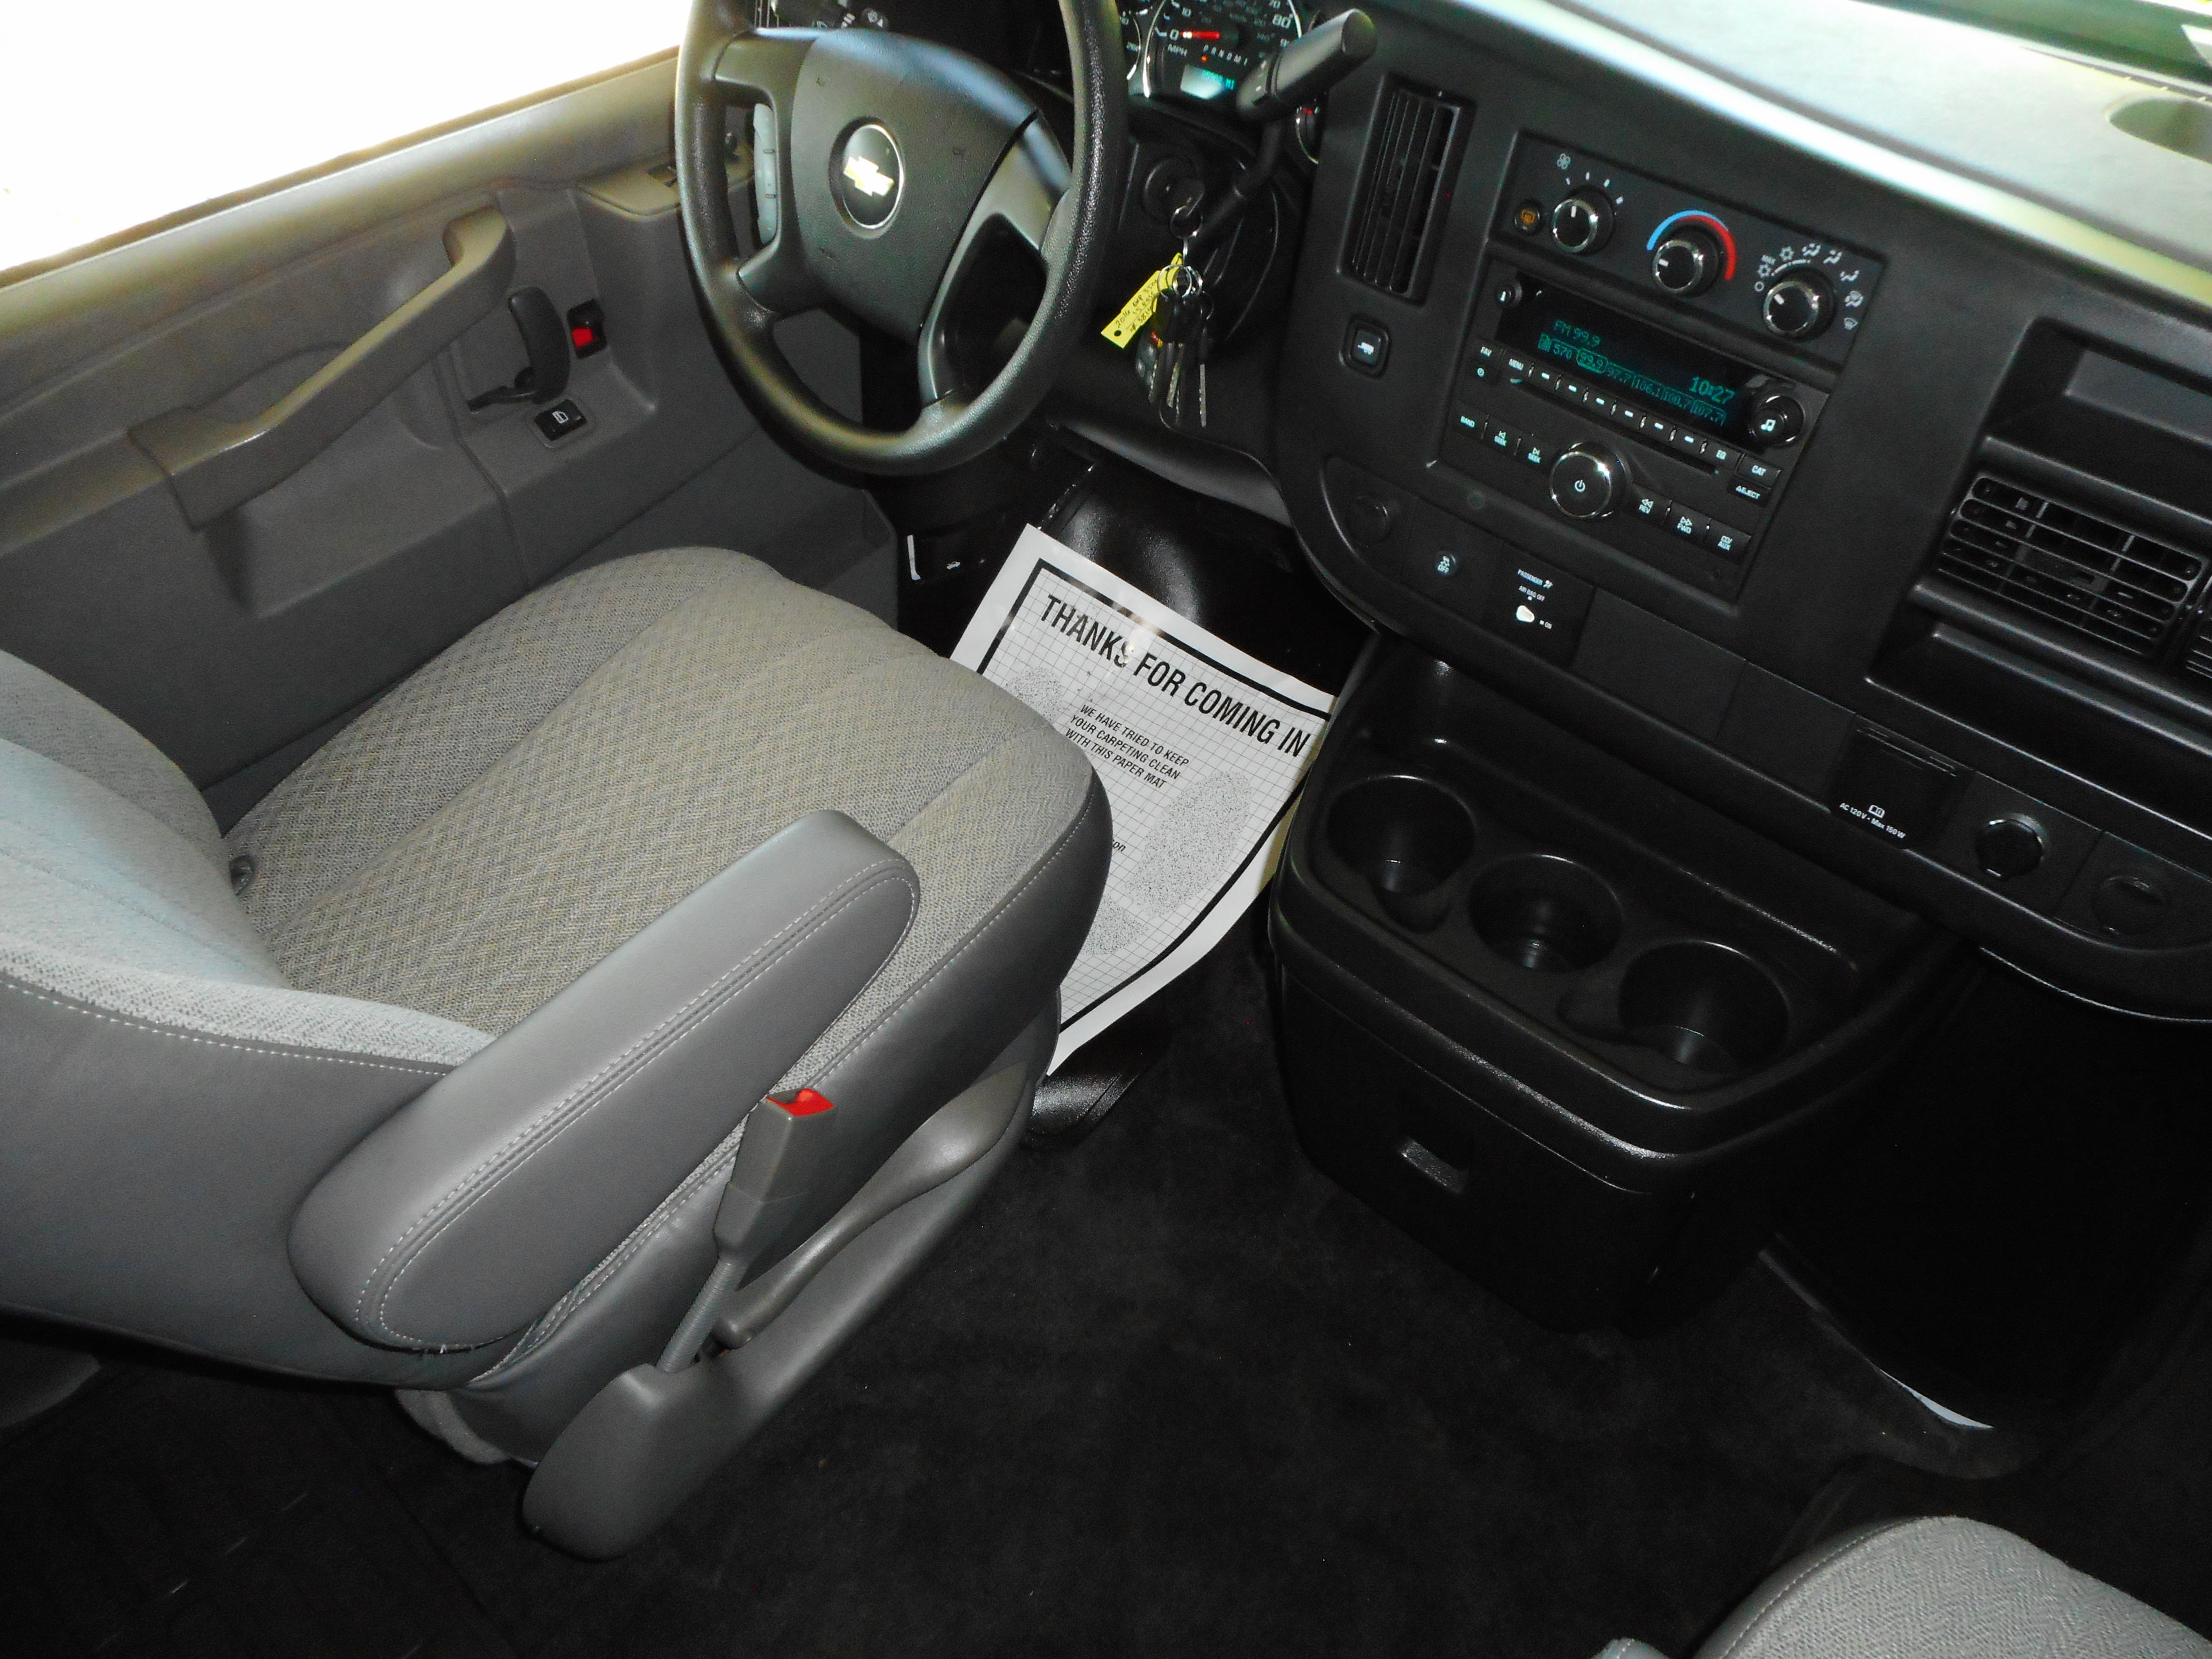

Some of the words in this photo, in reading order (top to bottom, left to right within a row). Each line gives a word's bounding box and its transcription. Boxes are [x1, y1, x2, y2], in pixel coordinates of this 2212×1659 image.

[1272, 14, 1291, 29] 80
[1170, 28, 1179, 40] 0
[1167, 43, 1188, 57] MPH
[1554, 319, 1571, 337] FM
[1573, 328, 1601, 347] 99.9
[1480, 346, 1492, 357] FAV
[1553, 343, 1572, 359] 570
[1580, 352, 1604, 368] 99.9
[1508, 359, 1524, 371] MENU
[1689, 376, 1735, 404] 10:27
[1461, 416, 1475, 428] BAND
[1494, 435, 1507, 446] SEEK
[1528, 453, 1541, 464] SEEK
[1716, 450, 1726, 460] EQ
[1751, 465, 1767, 477] CAT
[1741, 487, 1761, 499] EJECT
[1639, 504, 1651, 514] REV
[1677, 523, 1692, 534] FWD
[1717, 541, 1732, 550] AUX
[1721, 535, 1733, 544] CD/
[1437, 564, 1449, 574] OFF
[1517, 569, 1543, 586] PASSENGER
[1041, 594, 1134, 668] THANKS
[1133, 652, 1186, 697] FOR
[1184, 682, 1279, 744] COMING
[1278, 726, 1312, 758] IN
[1080, 705, 1097, 717] WE
[1095, 713, 1122, 731] HAVE
[1121, 726, 1150, 747] TRIED
[1150, 742, 1164, 754] TO
[1163, 750, 1189, 766] KEEP
[1070, 715, 1097, 734] YOUR
[1097, 730, 1149, 763] CARPETING
[1149, 759, 1181, 780] CLEAN
[1065, 728, 1091, 747] WITH
[1091, 742, 1113, 759] THIS
[1112, 754, 1144, 777] PAPER
[1144, 772, 1167, 789] MAT
[1839, 802, 1850, 811] AC
[1871, 818, 1885, 829] Max
